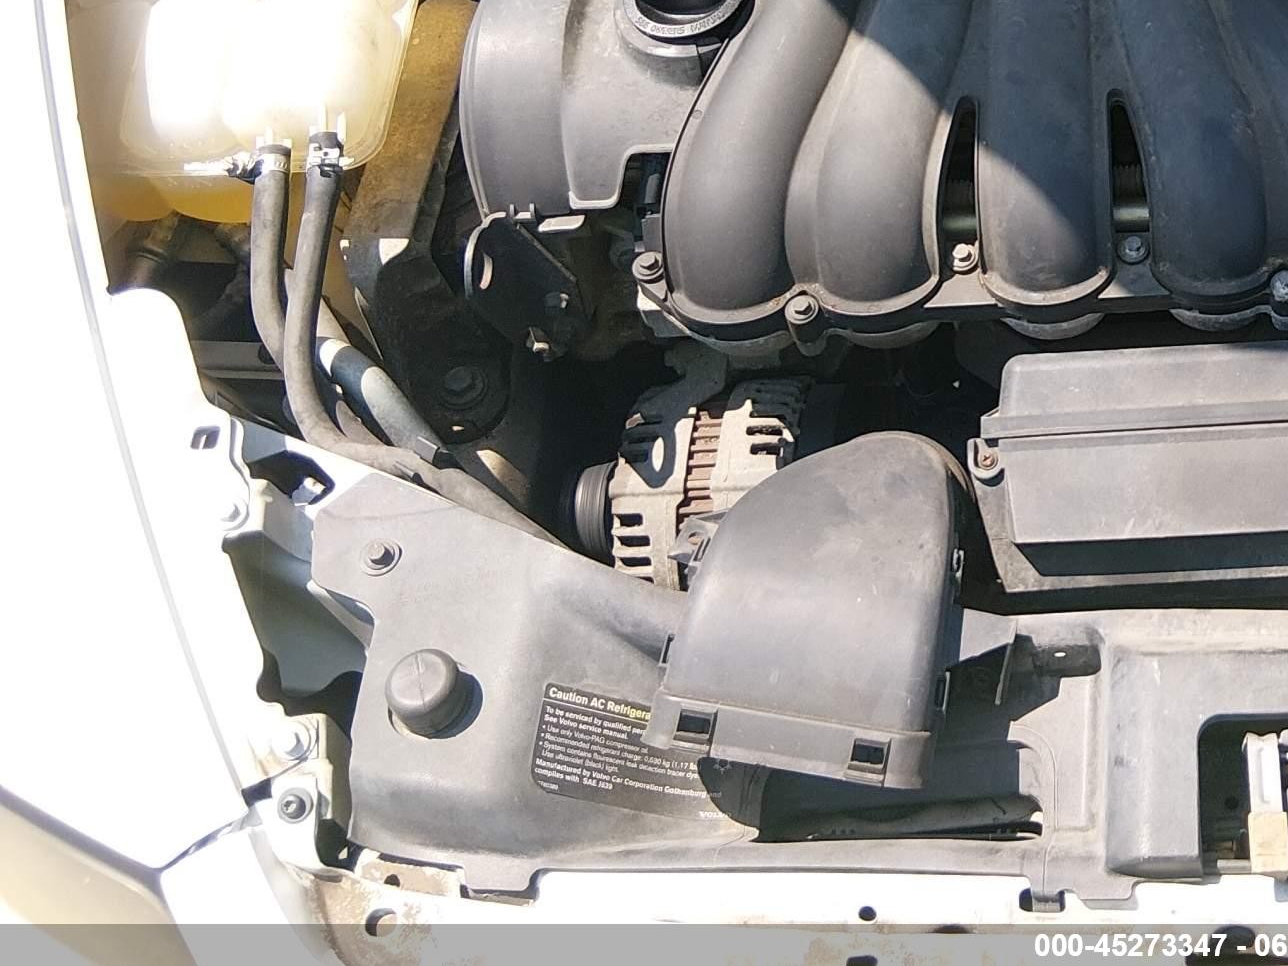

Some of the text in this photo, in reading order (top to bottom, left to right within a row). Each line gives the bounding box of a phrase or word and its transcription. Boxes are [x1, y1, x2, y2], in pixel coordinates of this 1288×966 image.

[549, 687, 588, 705] Caution
[590, 697, 606, 708] AC
[544, 714, 628, 739] See Volvo service manual.
[546, 706, 554, 714] To
[556, 708, 564, 716] be
[566, 711, 593, 722] serviced
[594, 717, 602, 726] by
[603, 719, 631, 732] qualified
[545, 733, 590, 749] Recommended
[591, 744, 620, 756] refrigerant
[663, 759, 670, 768] kg
[547, 724, 559, 733] Use
[561, 728, 572, 736] only
[606, 738, 640, 752] compressor
[542, 750, 554, 758] Use
[544, 741, 566, 753] System
[567, 747, 591, 758] contains
[626, 760, 637, 768] leak
[639, 762, 666, 774] detection
[667, 768, 685, 778] tracer
[534, 768, 564, 779] complies
[565, 774, 579, 783] with
[583, 778, 597, 787] SAE
[536, 758, 582, 774] Manufactured
[583, 768, 591, 778] by
[592, 771, 610, 781] Volvo
[624, 778, 663, 792] Corporation
[664, 786, 707, 798] Gothenburg
